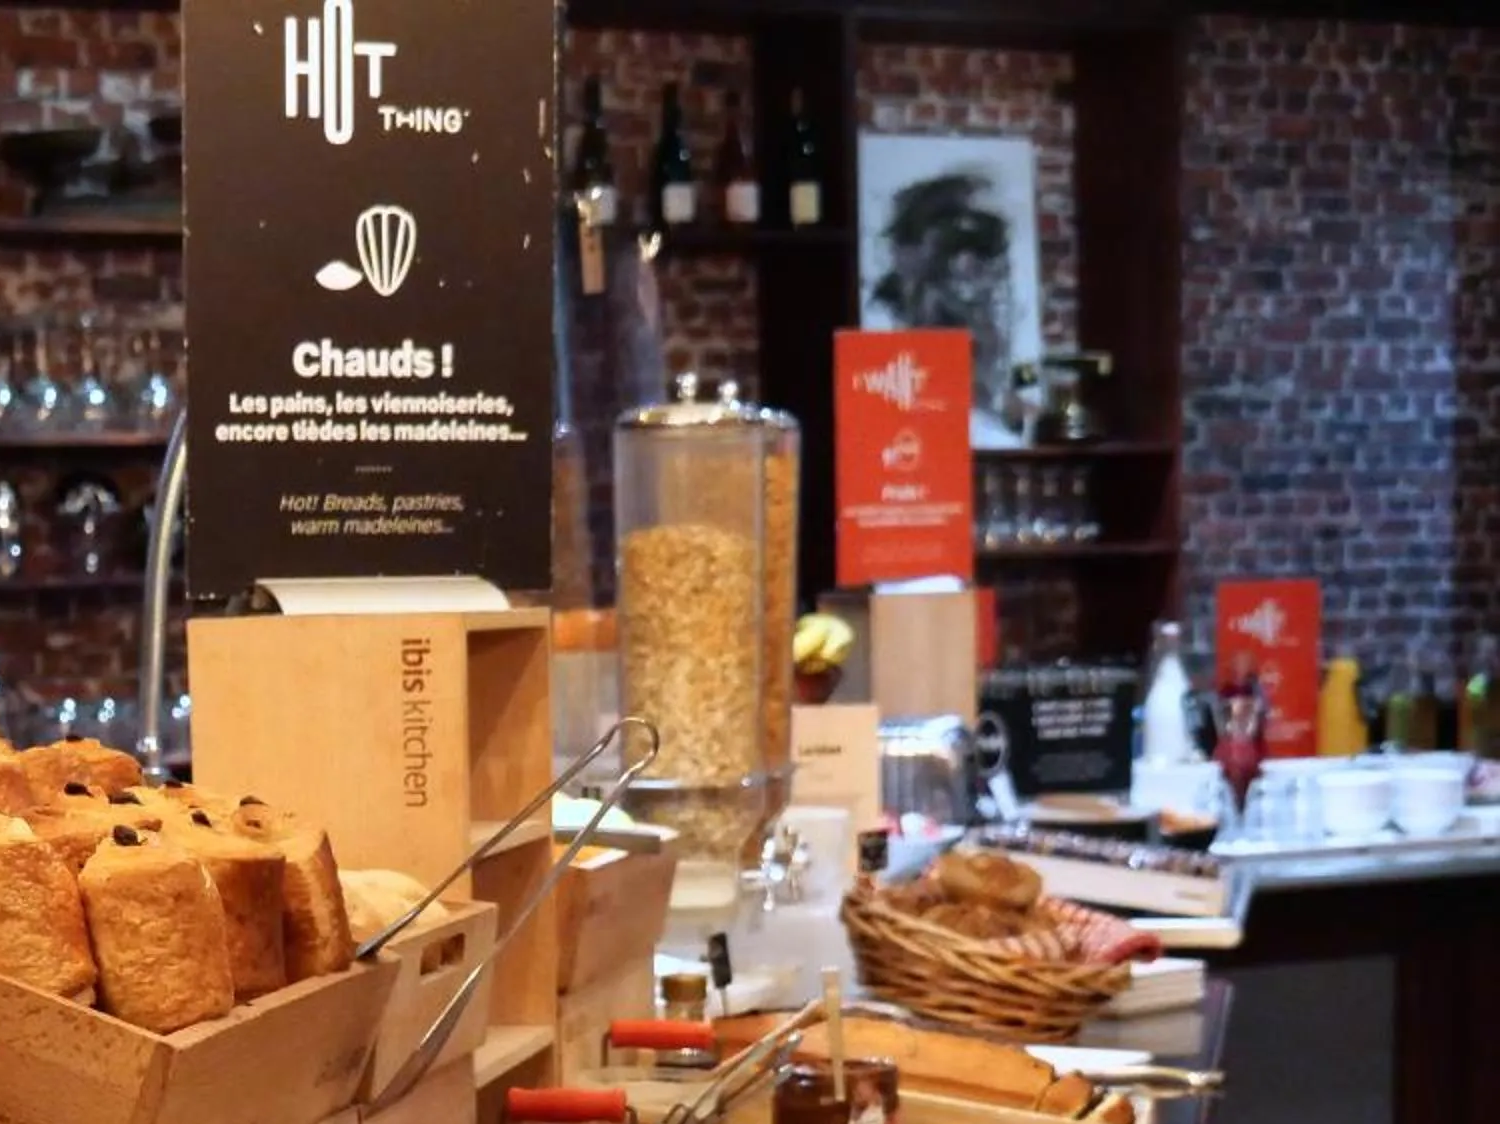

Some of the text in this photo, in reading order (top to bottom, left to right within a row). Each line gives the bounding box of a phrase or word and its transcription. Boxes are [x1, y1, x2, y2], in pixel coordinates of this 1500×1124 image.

[284, 0, 398, 145] HOT
[292, 338, 435, 378] Chauds
[229, 389, 514, 419] Les pains, les viennoiseries,
[215, 423, 289, 442] encore
[291, 418, 357, 442] tièdes
[360, 418, 391, 442] les
[291, 519, 339, 536] warm
[401, 637, 433, 808] ibis kitchen
